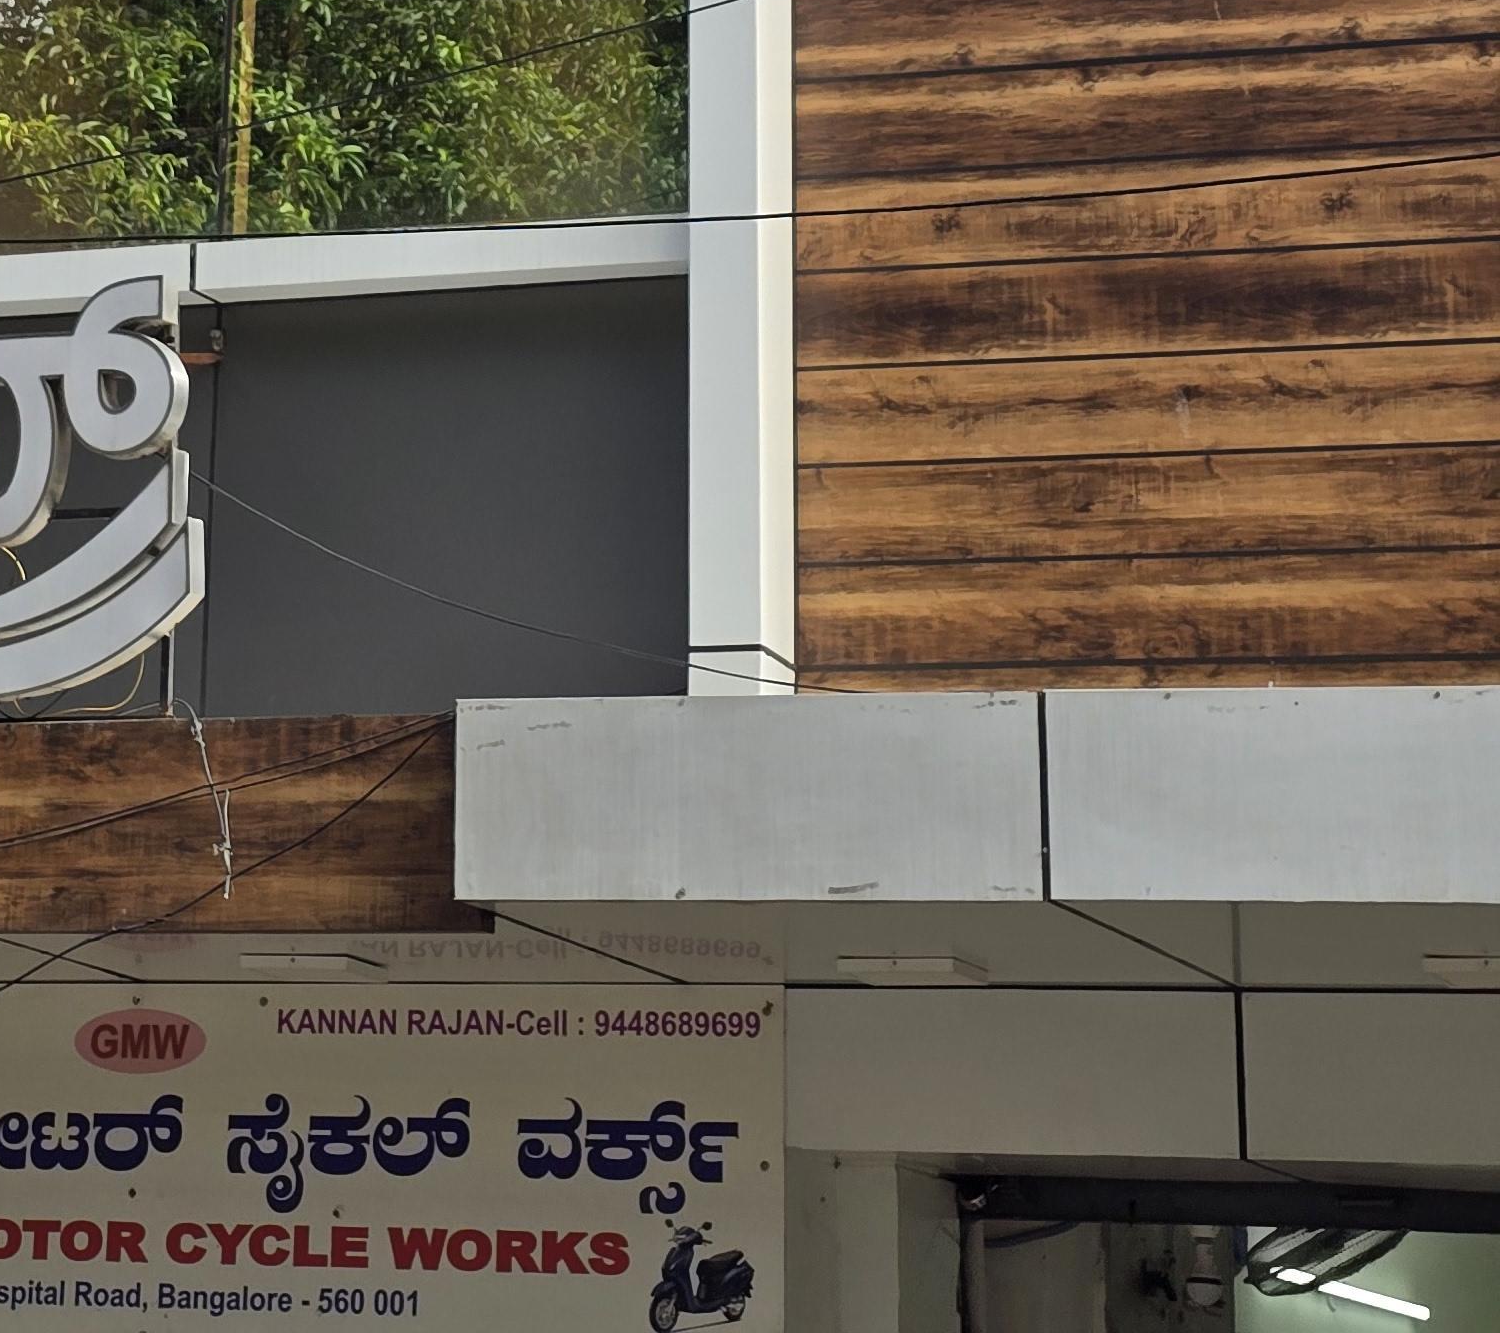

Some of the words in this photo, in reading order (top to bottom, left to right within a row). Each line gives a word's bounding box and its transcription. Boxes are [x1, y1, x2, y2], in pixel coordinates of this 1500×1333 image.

[90, 1023, 190, 1060] GMW
[277, 1008, 397, 1035] KANNAN
[407, 1009, 568, 1036] RAJAN-Cell
[594, 1009, 761, 1039] 9448689699
[226, 1093, 471, 1214] ಸೈಕಲ್
[516, 1097, 740, 1215] ವರ್ಕ್ಸ್
[165, 1222, 369, 1269] CYCLE
[388, 1226, 630, 1276] WORKS
[74, 1280, 148, 1313] Road,
[157, 1282, 293, 1317] Bangalore
[317, 1287, 365, 1315] 560
[373, 1288, 418, 1317] 001
